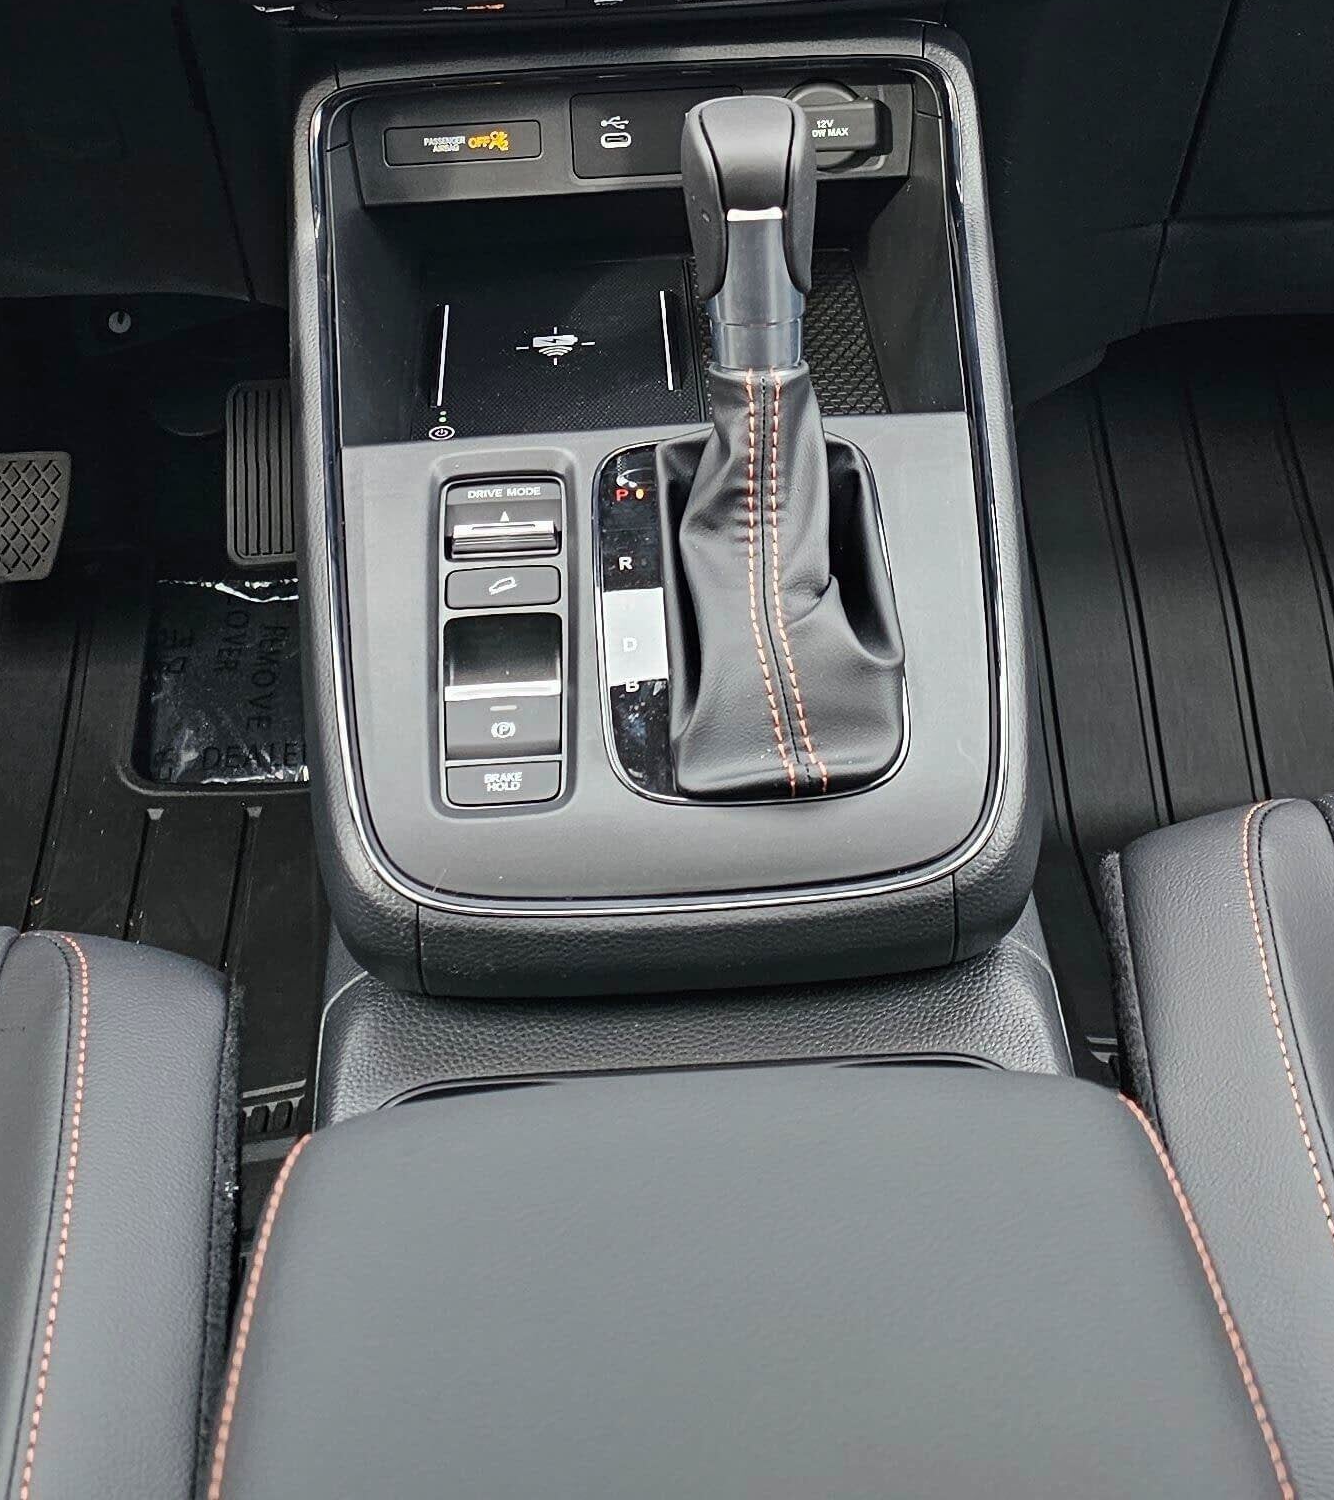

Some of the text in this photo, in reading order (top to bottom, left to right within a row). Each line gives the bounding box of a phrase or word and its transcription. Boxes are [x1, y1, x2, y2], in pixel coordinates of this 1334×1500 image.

[816, 119, 835, 129] 12V
[827, 127, 849, 137] MAX
[423, 135, 466, 147] PASSENGER
[467, 135, 491, 149] OFF
[433, 144, 460, 153] AIRBAG
[467, 486, 542, 499] DRIVE MODE
[616, 489, 629, 502] P
[618, 555, 634, 571] R
[623, 636, 638, 652] D
[625, 678, 640, 694] B
[484, 771, 523, 784] BRAKE
[486, 781, 521, 792] HOLD
